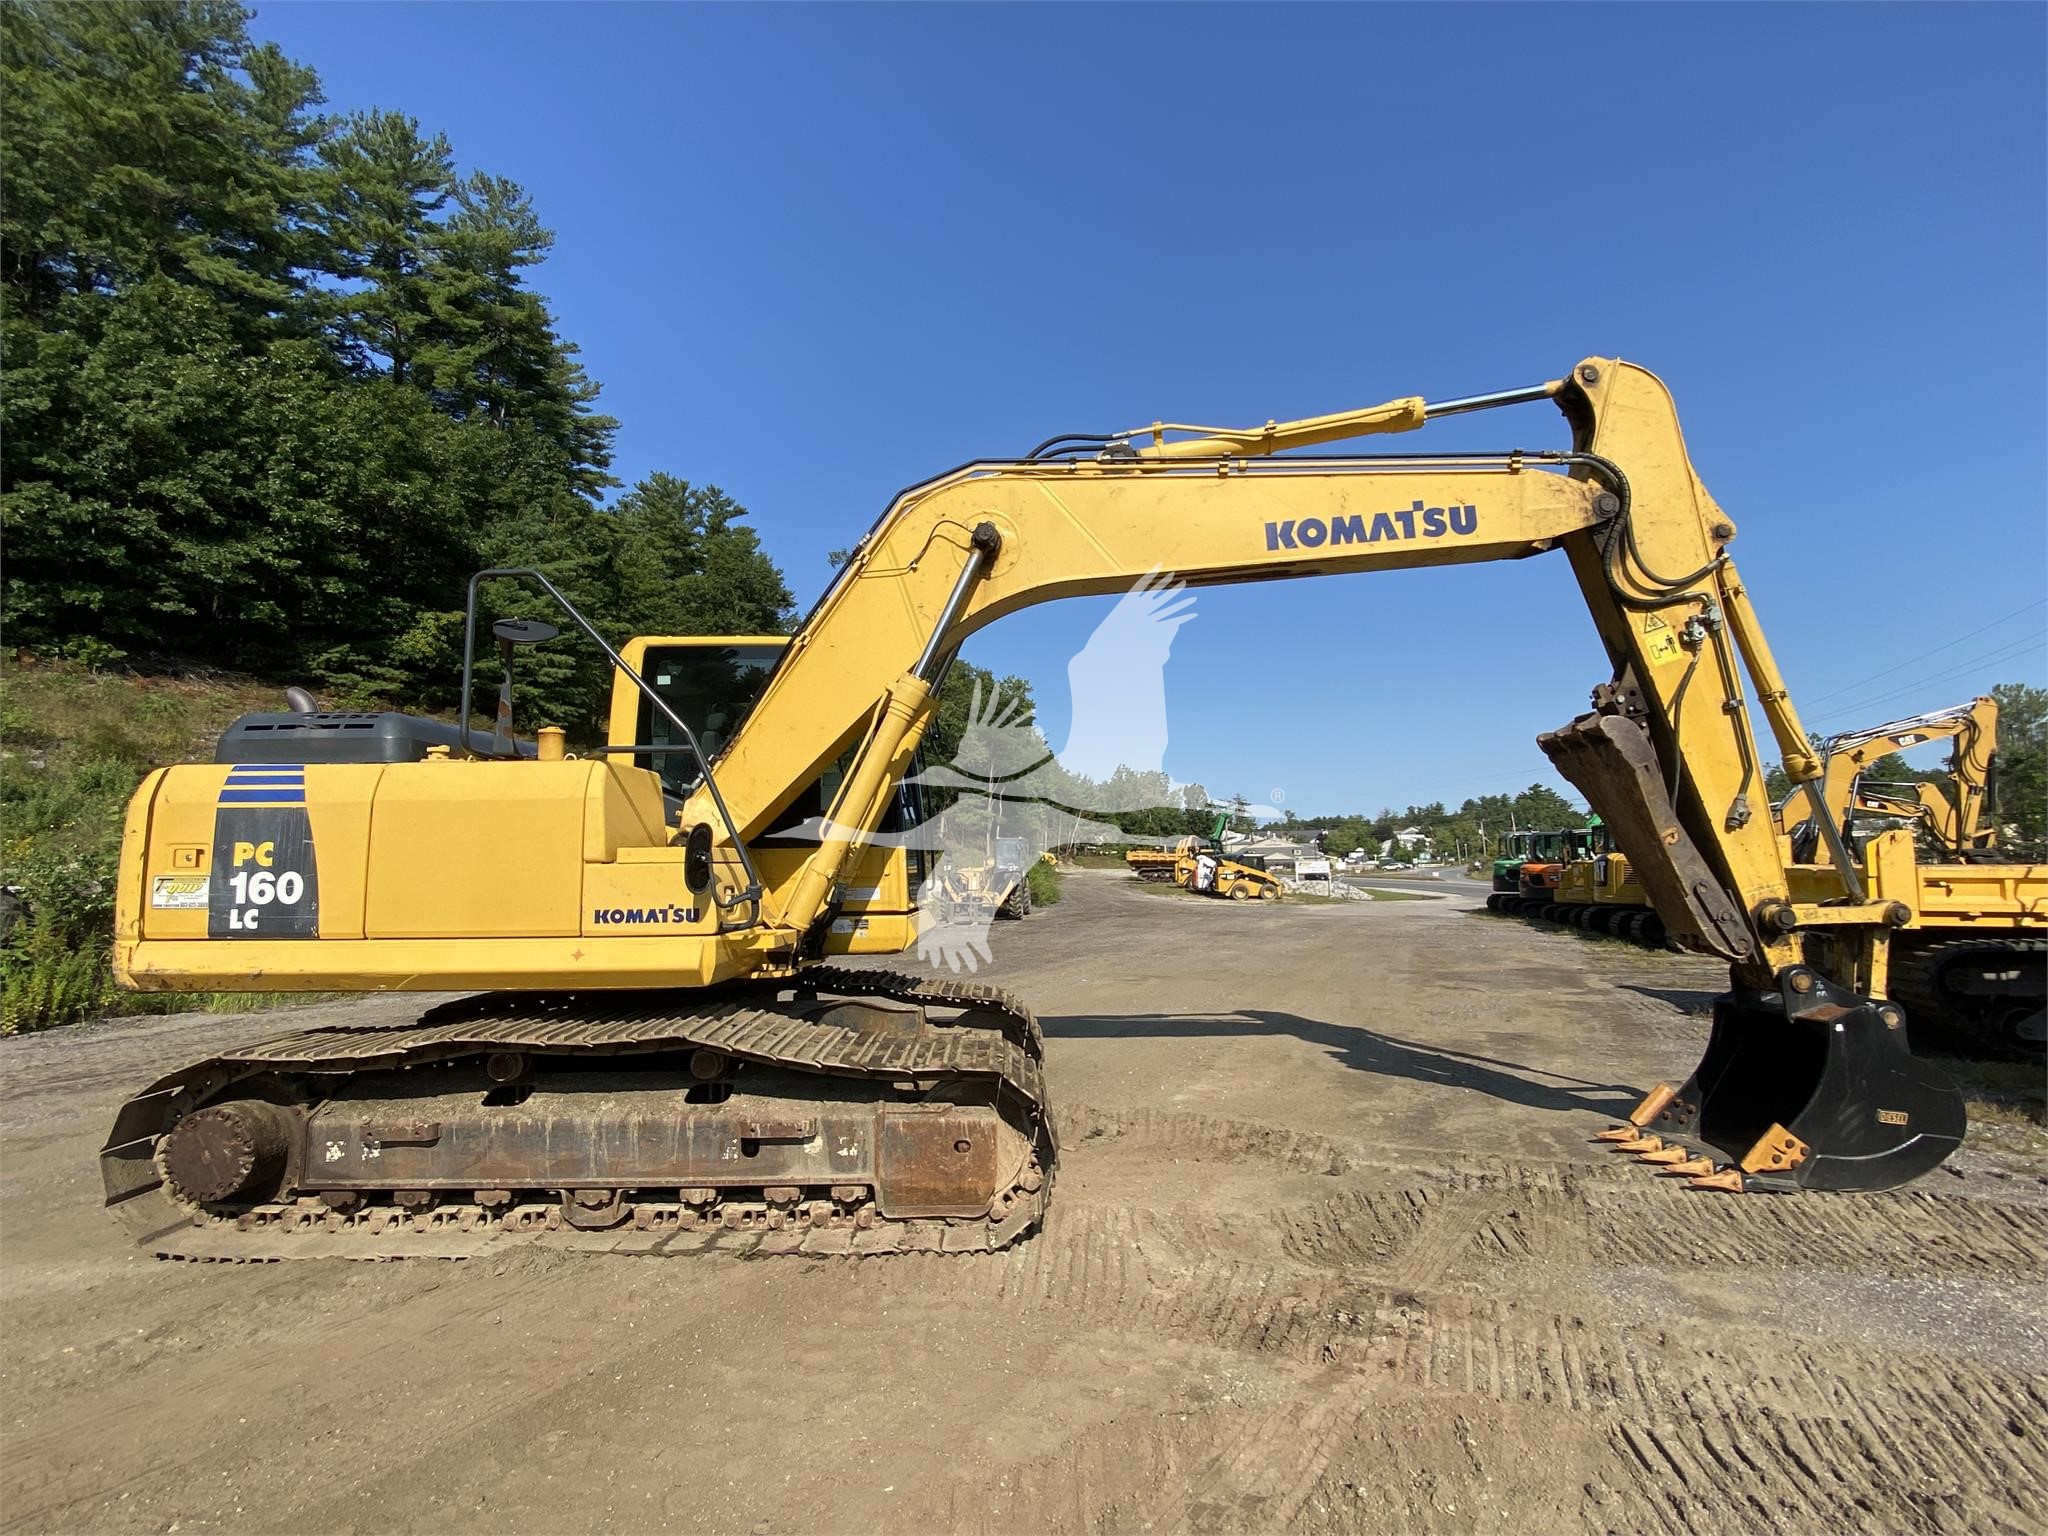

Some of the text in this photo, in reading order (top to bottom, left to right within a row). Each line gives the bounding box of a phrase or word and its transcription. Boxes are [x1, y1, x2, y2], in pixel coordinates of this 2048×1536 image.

[1264, 500, 1478, 551] KOMATSU
[233, 841, 275, 867] PC
[229, 871, 304, 905] 160
[229, 908, 259, 930] LC
[594, 903, 700, 924] KOMATSU
